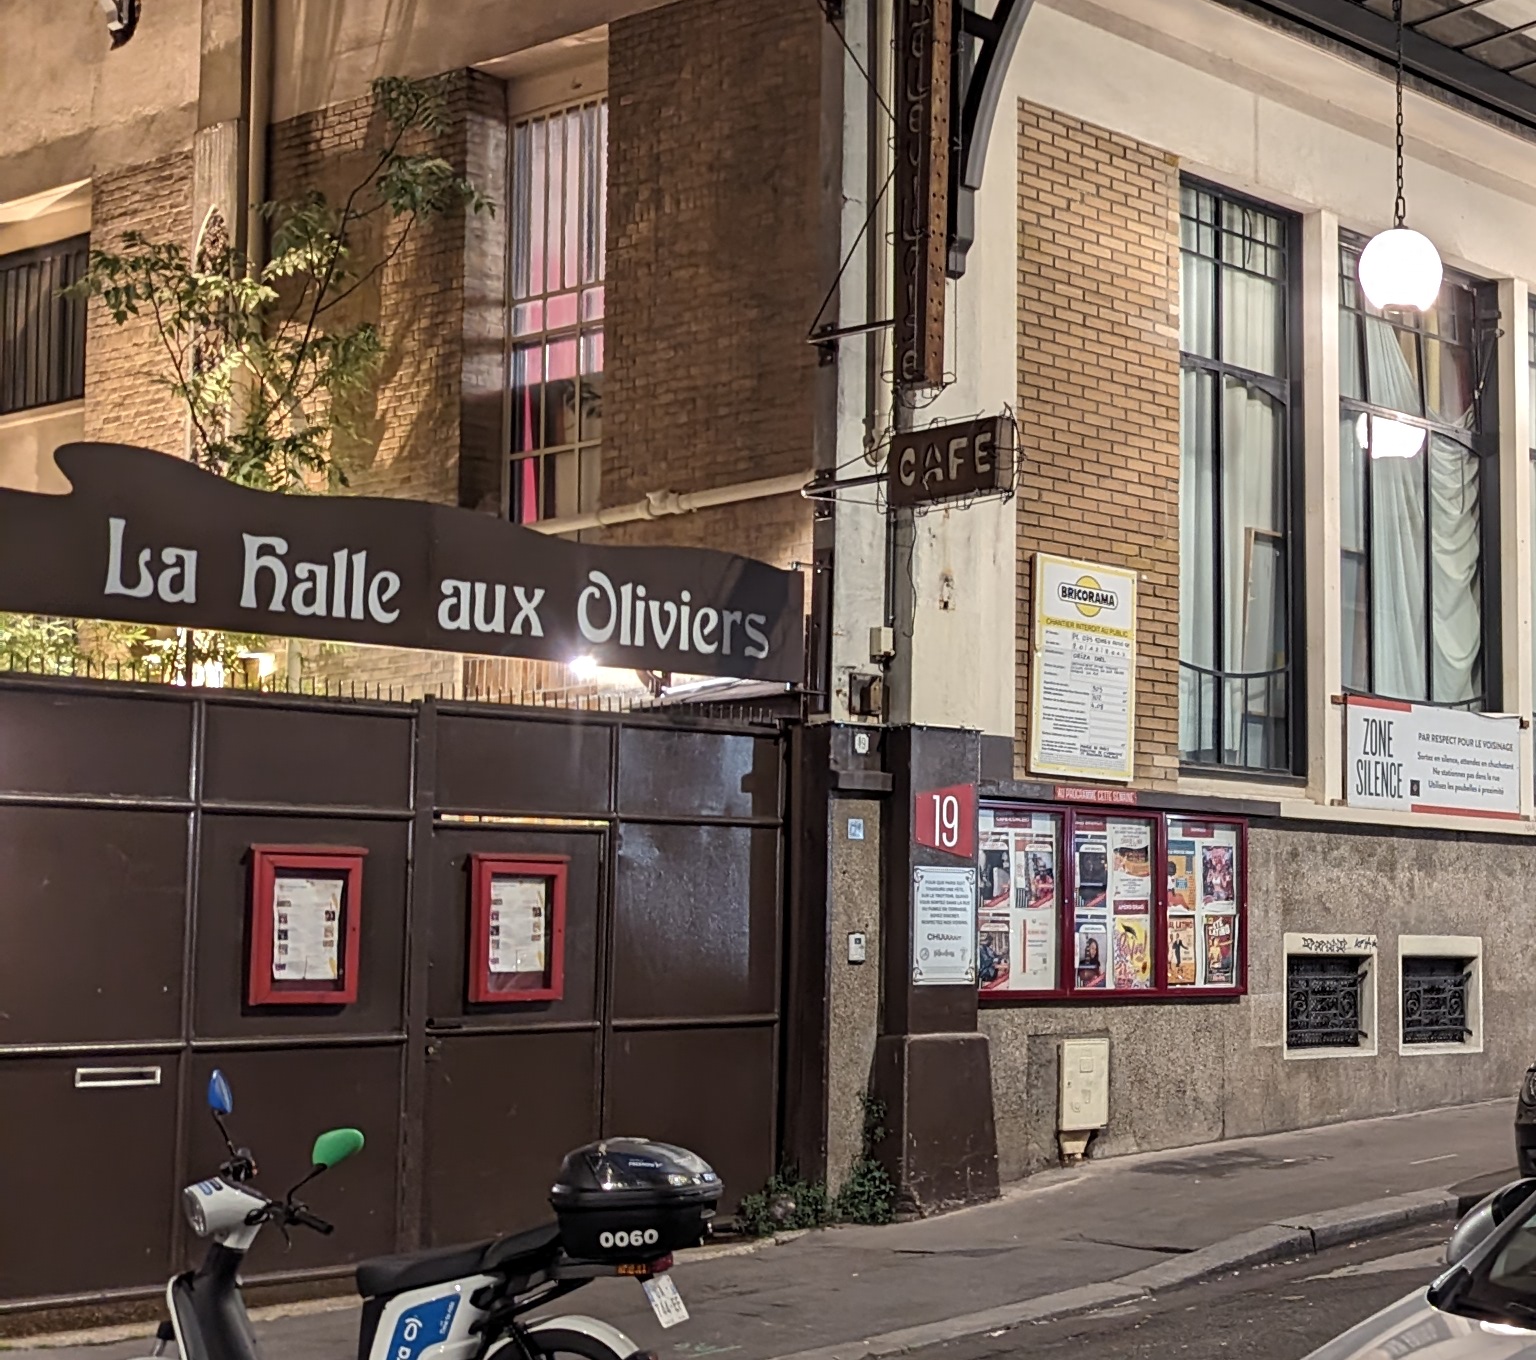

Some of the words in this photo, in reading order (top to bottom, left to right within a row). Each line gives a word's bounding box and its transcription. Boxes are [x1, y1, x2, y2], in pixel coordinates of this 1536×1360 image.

[104, 518, 198, 605] La
[239, 532, 401, 624] Halle
[437, 577, 546, 638] aux
[576, 569, 770, 660] Oliviers
[1061, 585, 1115, 607] BRICORAMA
[1362, 717, 1394, 759] ZONE
[1418, 733, 1431, 742] PAR
[1432, 734, 1457, 745] RESPECT
[1458, 738, 1474, 747] POUR
[1475, 740, 1482, 748] LE
[1483, 741, 1514, 752] VOISINAGE
[1356, 759, 1403, 799] SILENCE
[1066, 788, 1097, 801] PROGRAMME
[1098, 791, 1113, 802] CETTE
[1113, 791, 1135, 803] SEMAINE
[932, 794, 959, 849] 19
[600, 1229, 659, 1249] 0060
